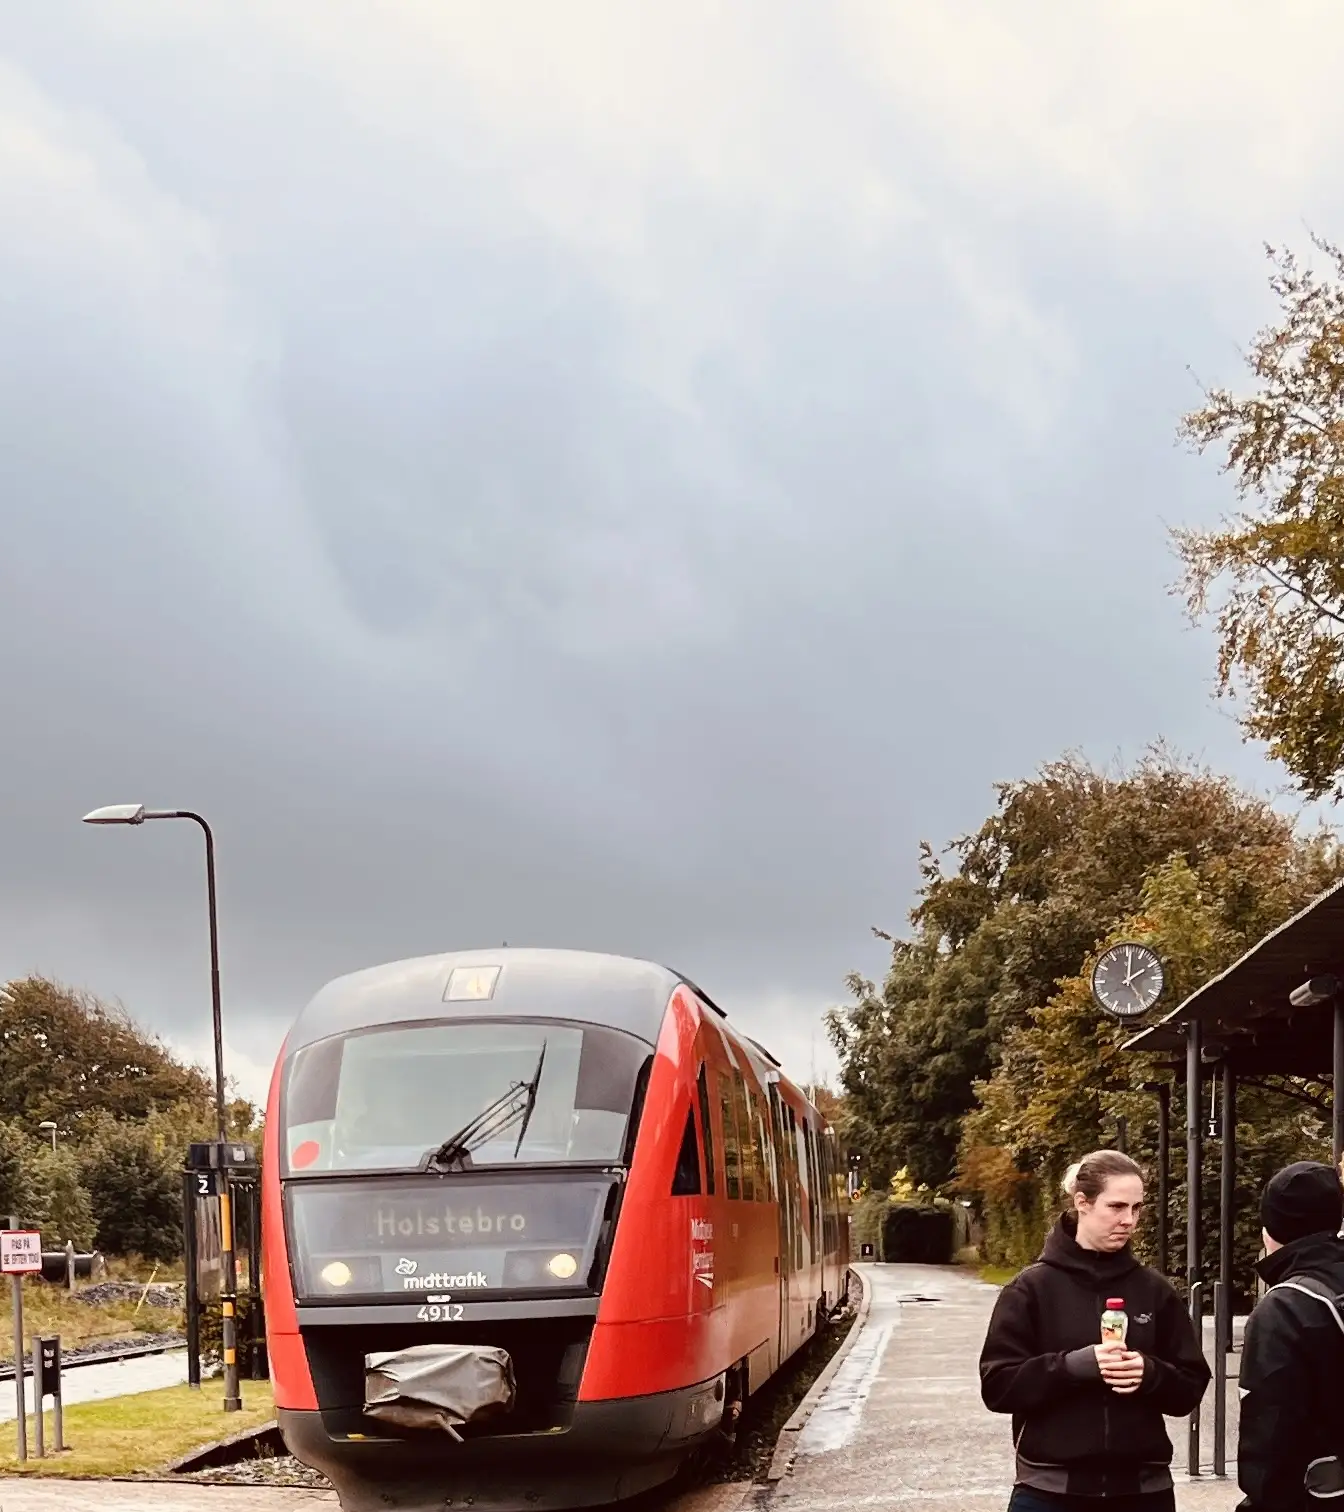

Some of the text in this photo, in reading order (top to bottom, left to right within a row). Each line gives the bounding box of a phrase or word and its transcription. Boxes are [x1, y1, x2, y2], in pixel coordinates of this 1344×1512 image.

[1208, 1124, 1217, 1136] 1
[198, 1179, 209, 1193] 2
[376, 1205, 526, 1237] Holstebro
[403, 1271, 488, 1290] midttrafik
[416, 1304, 464, 1322] 4912
